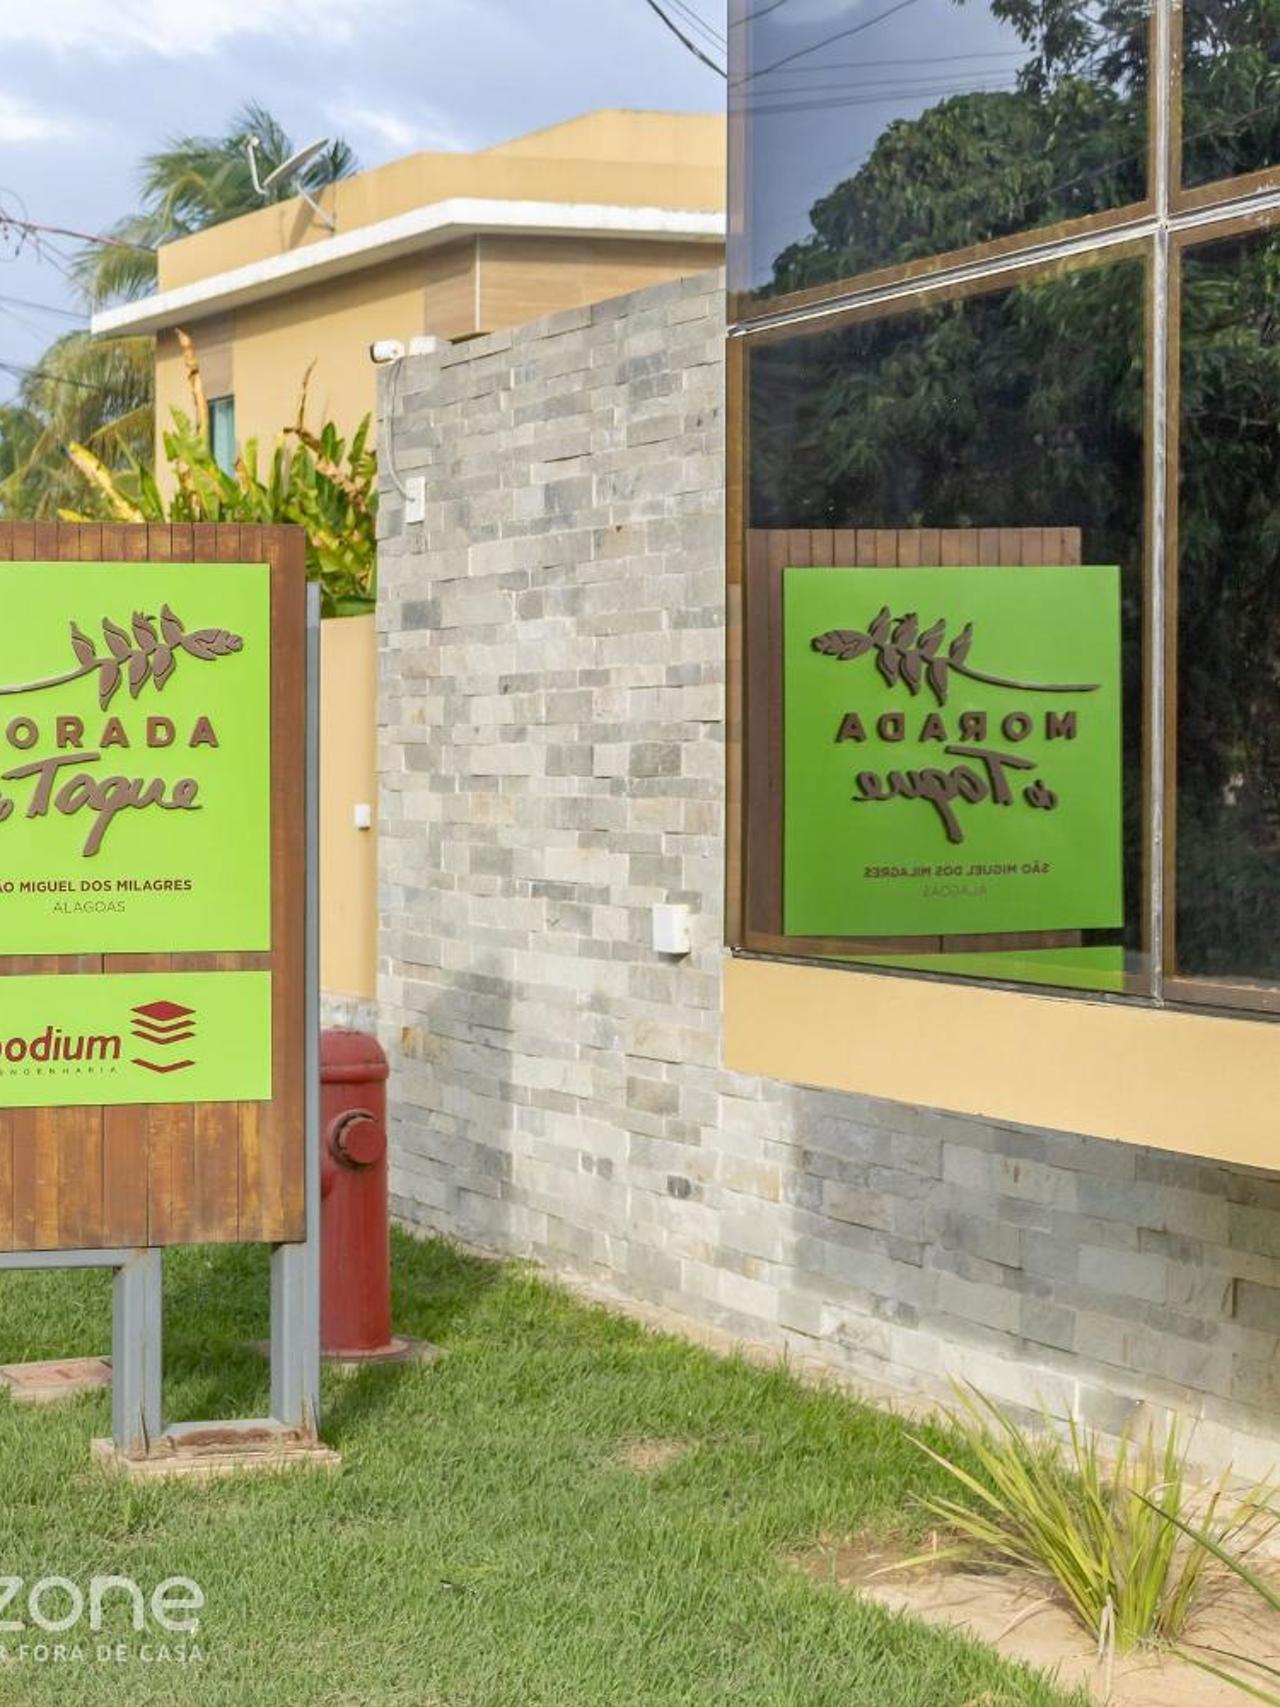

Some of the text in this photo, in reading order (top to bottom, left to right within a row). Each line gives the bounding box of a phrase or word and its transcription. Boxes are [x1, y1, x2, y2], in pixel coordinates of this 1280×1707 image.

[0, 751, 203, 858] Toque
[19, 881, 76, 893] MIGUEL
[80, 879, 112, 892] DOS
[116, 879, 193, 892] MILAGRES
[52, 900, 126, 914] ALAGOAS
